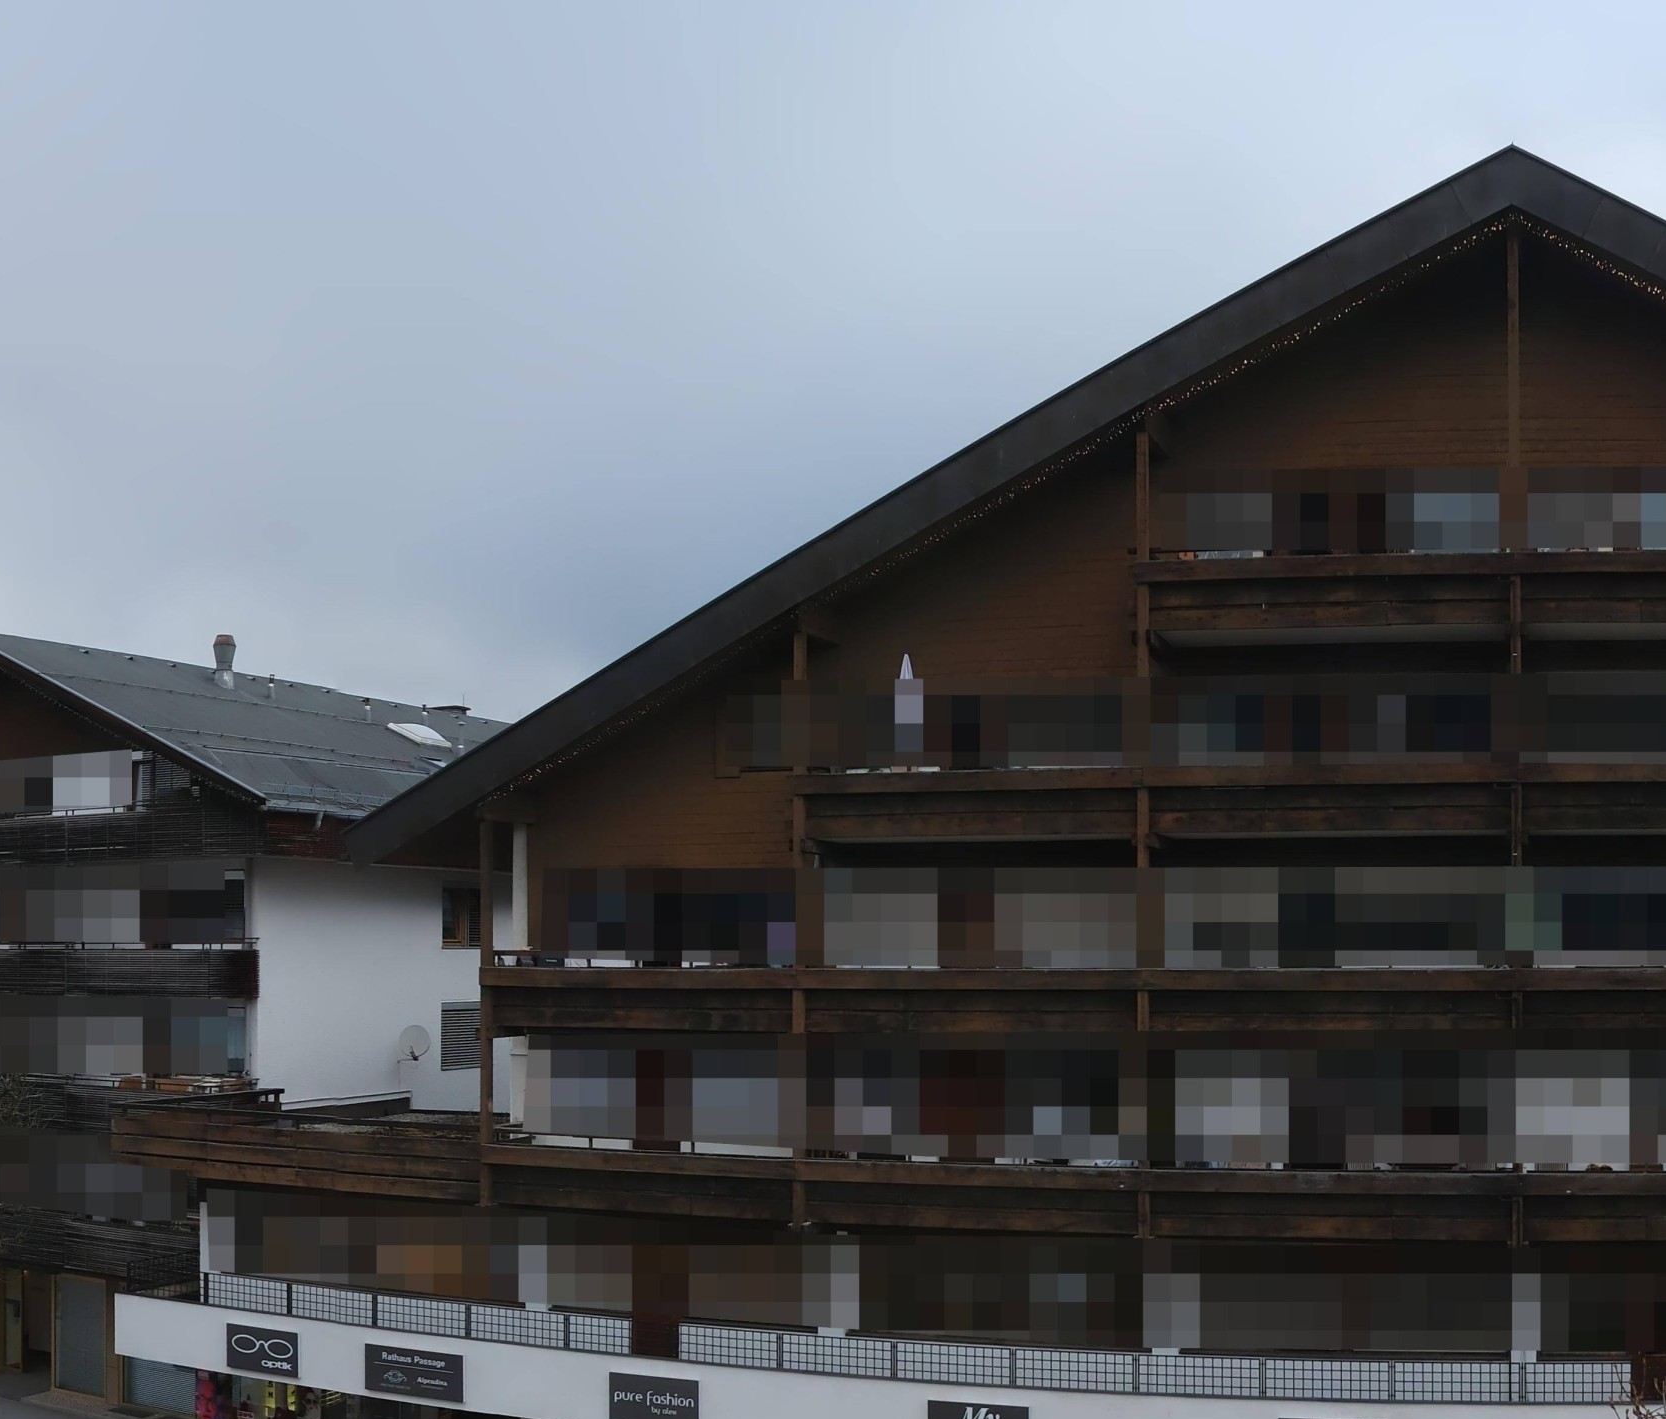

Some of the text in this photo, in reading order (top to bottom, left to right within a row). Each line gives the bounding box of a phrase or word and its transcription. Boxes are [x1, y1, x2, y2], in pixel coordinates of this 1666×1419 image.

[261, 1358, 292, 1371] optik
[381, 1351, 445, 1368] Rathaus Passage
[614, 1390, 694, 1408] pure fashion
[651, 1406, 660, 1415] by
